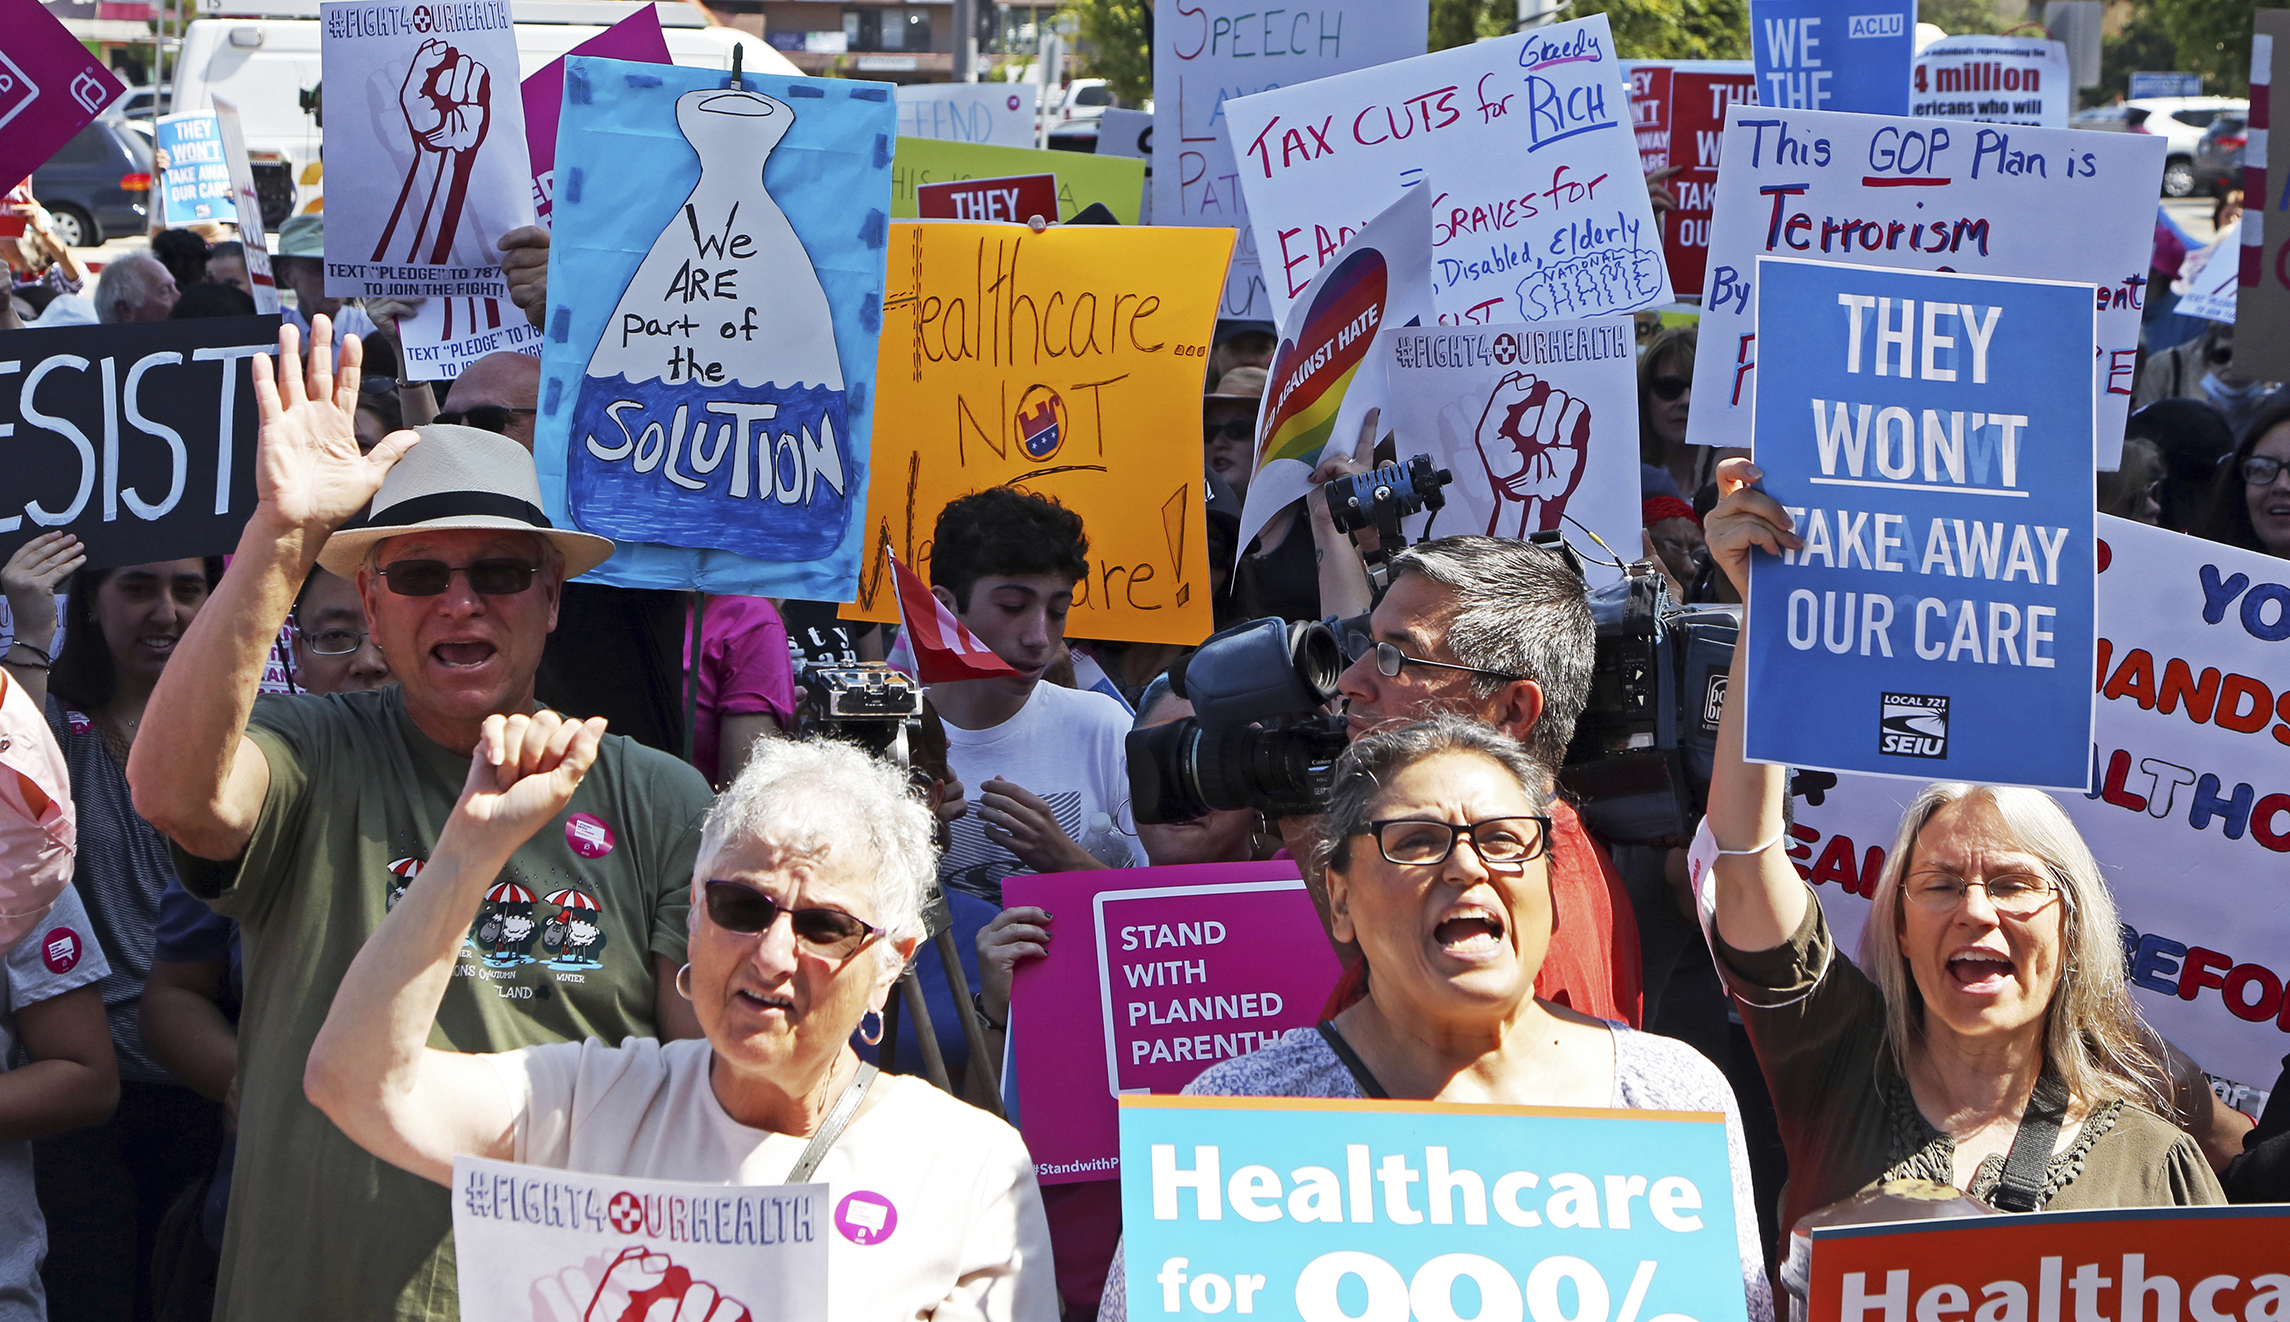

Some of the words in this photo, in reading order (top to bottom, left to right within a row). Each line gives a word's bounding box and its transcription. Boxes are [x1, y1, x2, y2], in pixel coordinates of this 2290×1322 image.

[1174, 0, 1342, 60] SPEECH
[1765, 17, 1821, 68] WE
[1852, 15, 1901, 36] ACLU
[1766, 71, 1832, 110] THE
[1936, 62, 2040, 92] million
[1247, 115, 1334, 178] TAX
[1352, 85, 1460, 145] CUTS
[1477, 72, 1514, 125] for
[1524, 75, 1606, 143] RICH
[1913, 99, 1975, 116] ericans
[1978, 98, 2008, 115] who
[2013, 98, 2042, 115] will
[174, 119, 212, 141] THEY
[172, 140, 221, 161] WON'T
[1738, 119, 1831, 168] This
[1869, 127, 1949, 174] GOP
[1971, 129, 2046, 180] Plan
[2067, 147, 2096, 178] is
[168, 166, 197, 185] TAKE
[171, 185, 197, 202] OUR
[1179, 151, 1249, 216] PAT
[1543, 164, 1608, 210] for
[950, 187, 1019, 222] THEY
[1759, 183, 1989, 257] Terrorism
[685, 201, 758, 261] We
[1437, 242, 1543, 287] Disabled,
[1549, 211, 1640, 259] Elderly
[328, 263, 366, 279] TEXT
[451, 268, 468, 280] TO
[664, 266, 738, 303] ARE
[1543, 252, 1625, 284] NATIONAL
[364, 282, 382, 296] TO
[386, 282, 422, 296] JOIN
[423, 282, 452, 296] THE
[457, 282, 504, 298] FIGHT!
[1528, 258, 1658, 322] SHAME
[1708, 266, 1751, 315] By
[406, 345, 440, 361] TEXT
[505, 327, 523, 345] TO
[622, 312, 700, 349] part
[720, 305, 759, 342] of
[1838, 293, 2003, 384] THEY
[439, 362, 457, 377] TO
[667, 348, 725, 384] the
[1276, 338, 1335, 414] AGAINST
[1338, 302, 1380, 351] HATE
[585, 399, 845, 509] SOLUTION
[1811, 398, 2029, 488] WON'T
[1781, 505, 1903, 573] TAKE
[1921, 518, 2069, 586] AWAY
[1787, 588, 1894, 657] OUR
[1915, 597, 2057, 668] CARE
[1884, 694, 1922, 707] LOCAL
[1926, 695, 1947, 708] 721
[1882, 735, 1943, 756] SEIU
[1120, 920, 1227, 951] STAND
[493, 984, 533, 999] LAND
[555, 973, 585, 984] WINTER
[1123, 959, 1207, 989] WITH
[1128, 992, 1284, 1027] PLANNED
[1151, 1143, 1704, 1231] Healthcare
[1157, 1256, 1266, 1314] for
